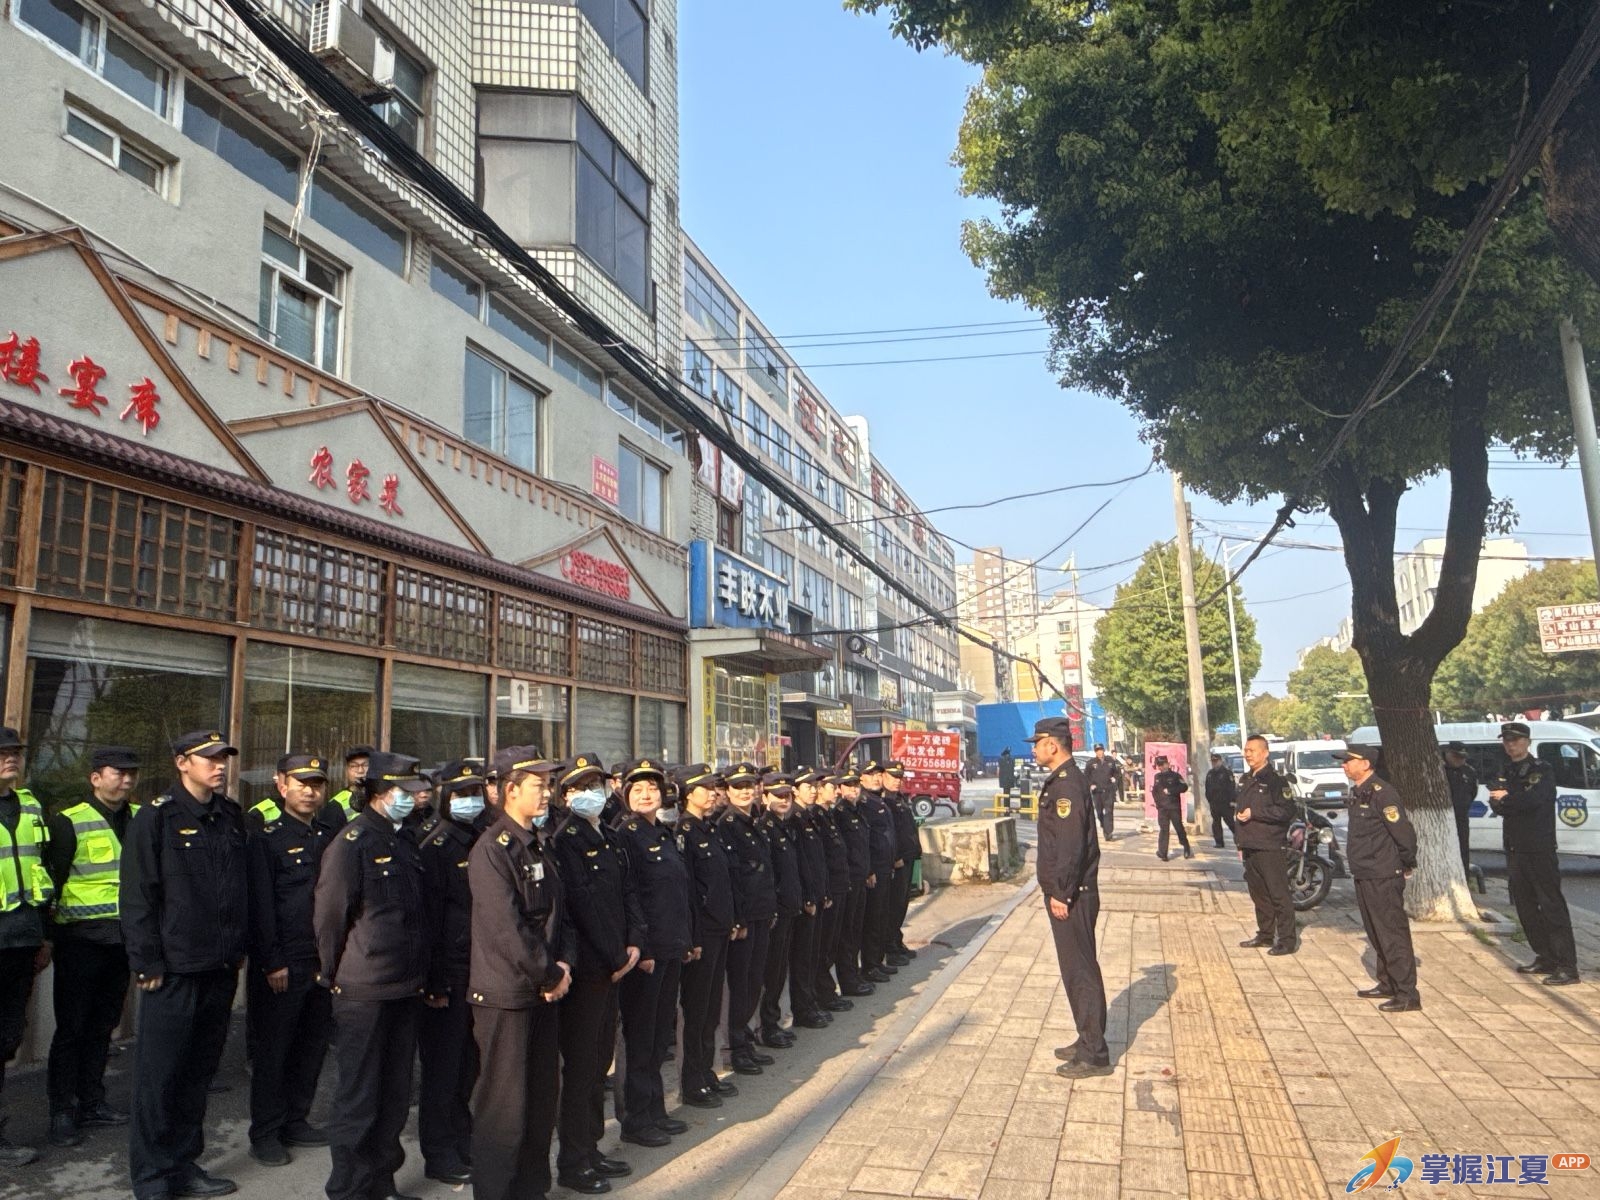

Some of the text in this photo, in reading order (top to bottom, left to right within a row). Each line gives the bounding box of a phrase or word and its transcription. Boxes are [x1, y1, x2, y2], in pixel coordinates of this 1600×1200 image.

[308, 444, 404, 517] 农家菜
[717, 559, 789, 632] 丰联木业
[901, 732, 951, 746] 十一万瓷砖
[906, 744, 946, 757] 批发仓库
[893, 756, 957, 769] 5527556896
